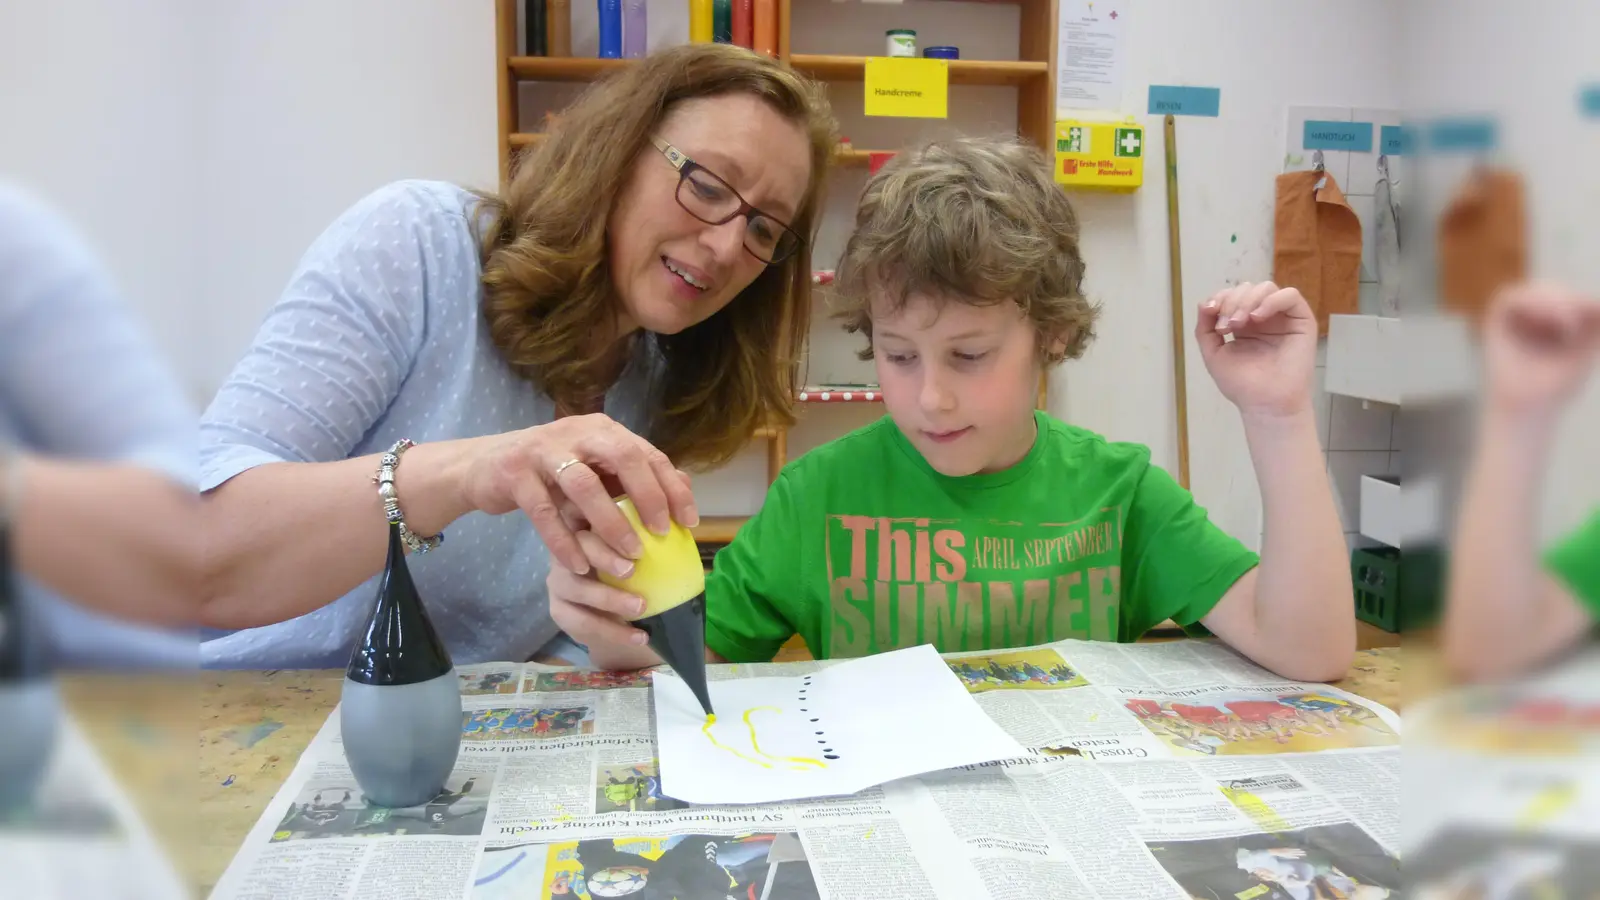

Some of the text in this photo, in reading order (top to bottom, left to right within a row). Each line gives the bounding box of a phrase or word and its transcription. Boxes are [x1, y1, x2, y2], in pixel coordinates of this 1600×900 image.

[874, 88, 922, 97] Handcreme
[1156, 101, 1182, 110] BESEN
[1311, 131, 1355, 142] HANDTUCH
[1080, 160, 1114, 168] Erste Hilfe
[1097, 168, 1133, 176] Handwerk
[842, 515, 1114, 583] This APRIL SEPTEMBER
[830, 566, 1121, 660] SUMMER
[540, 739, 631, 751] Pfarrkirchen
[1071, 739, 1120, 748] ersten
[500, 745, 536, 753] stellt
[432, 813, 443, 822] 3
[635, 817, 674, 827] weist
[678, 814, 756, 823] Hutthurm
[761, 813, 783, 822] SV
[499, 824, 559, 835] zurecht
